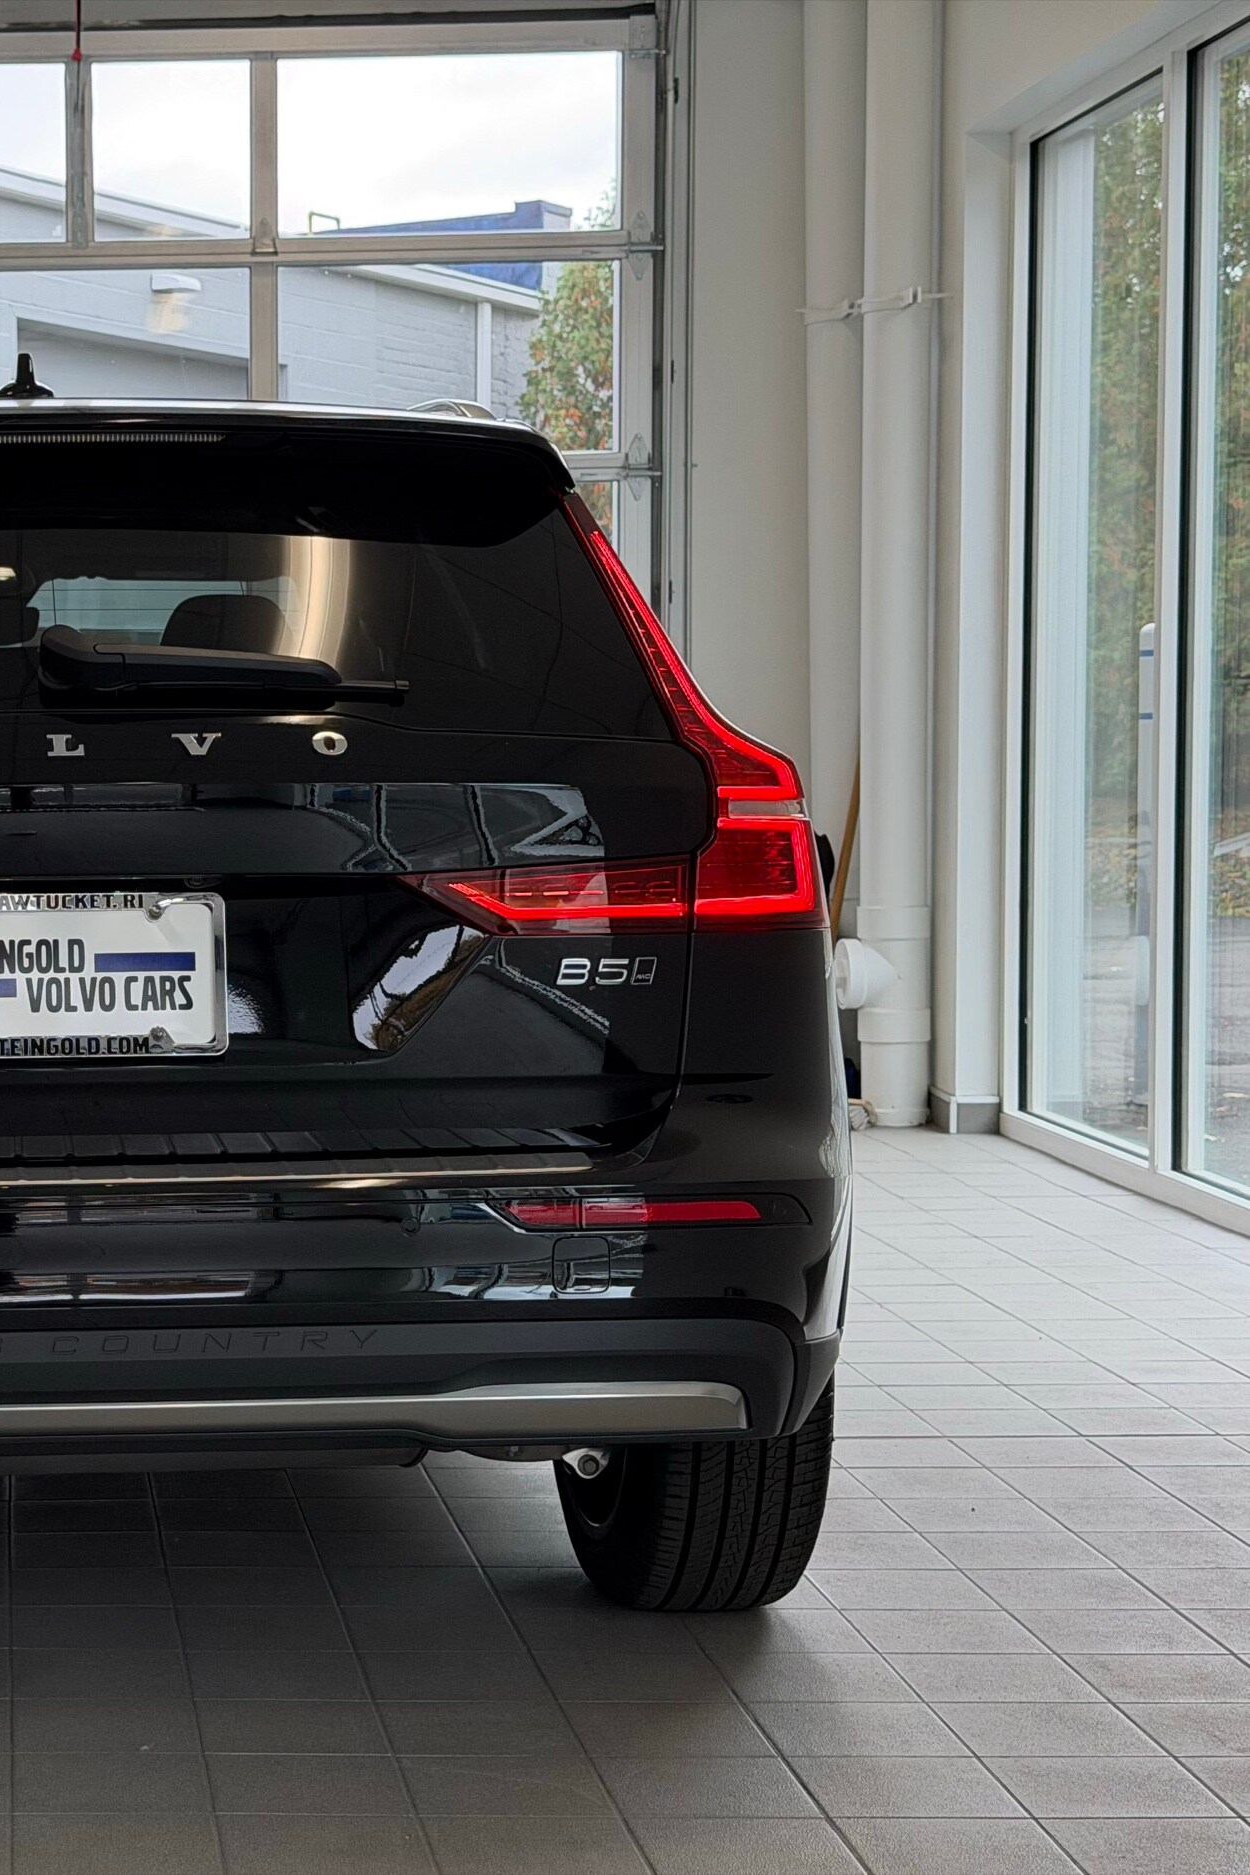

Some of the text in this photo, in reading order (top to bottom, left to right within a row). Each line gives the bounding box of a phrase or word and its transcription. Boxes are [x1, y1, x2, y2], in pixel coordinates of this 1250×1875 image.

[123, 894, 144, 909] RI
[556, 957, 630, 986] B5
[26, 975, 193, 1013] VOLVO CARS
[52, 1329, 378, 1355] COUNTRY
